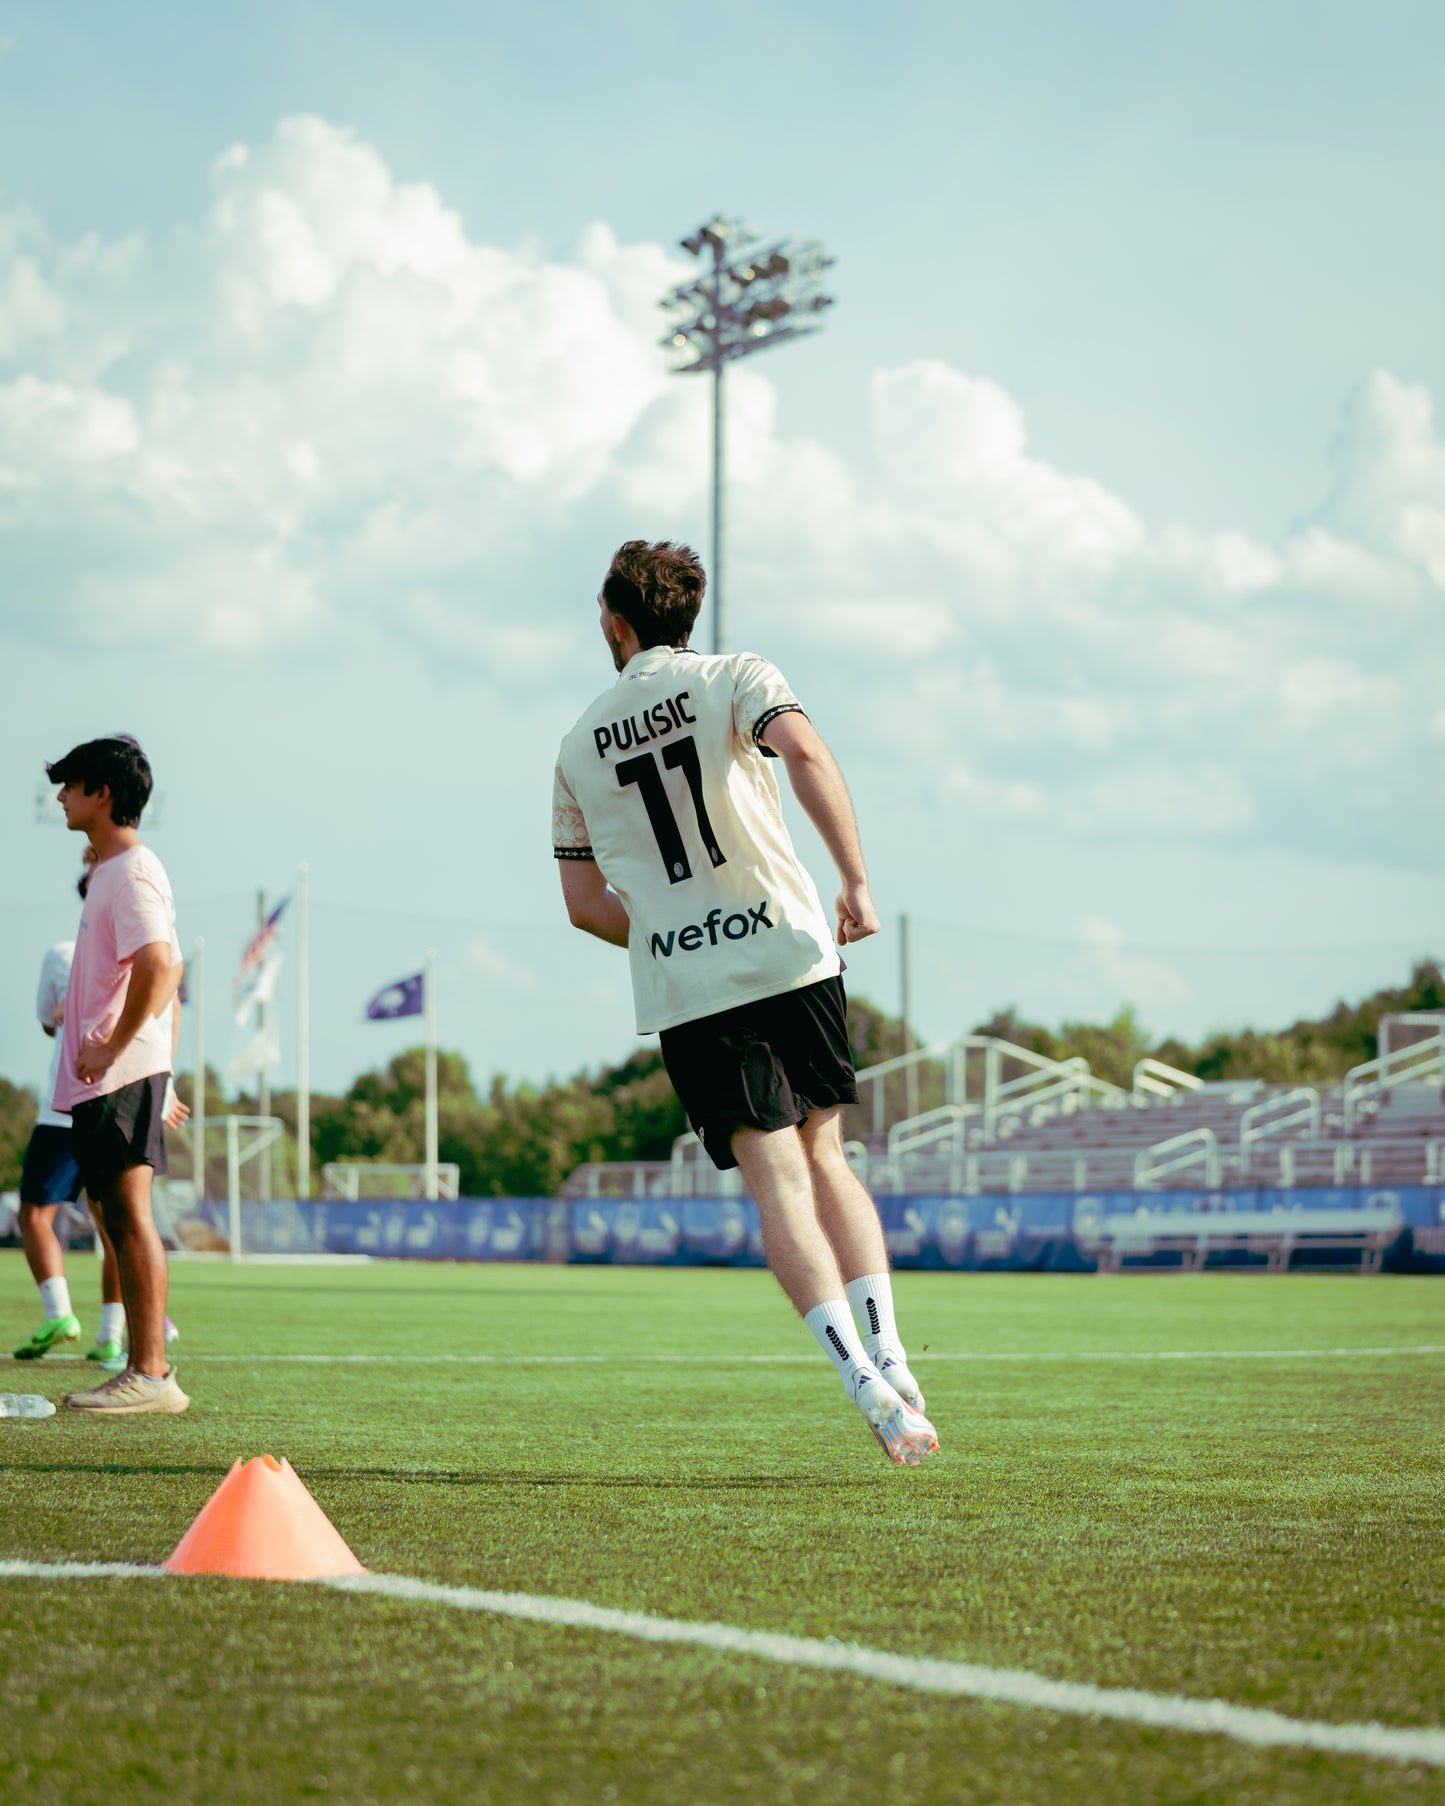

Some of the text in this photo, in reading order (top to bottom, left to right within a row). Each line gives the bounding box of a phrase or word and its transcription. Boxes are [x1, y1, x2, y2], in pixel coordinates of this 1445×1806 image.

[594, 692, 696, 759] PULISIC
[615, 735, 727, 884] 11
[646, 901, 774, 960] wefox
